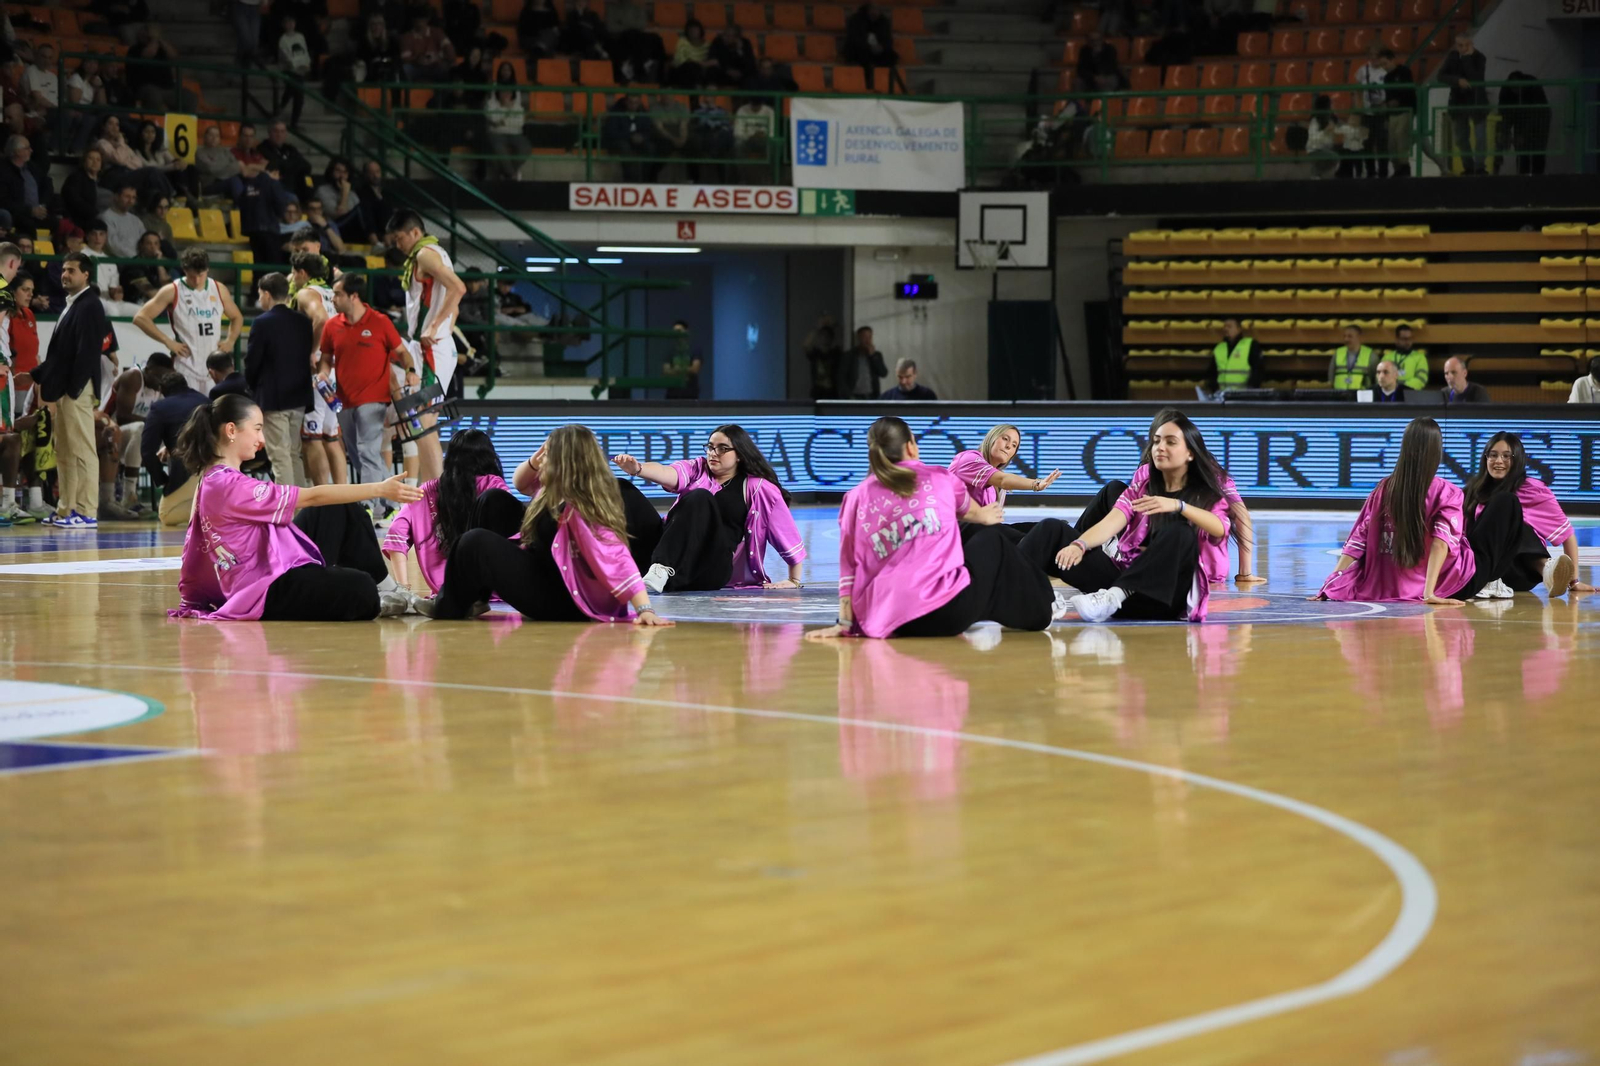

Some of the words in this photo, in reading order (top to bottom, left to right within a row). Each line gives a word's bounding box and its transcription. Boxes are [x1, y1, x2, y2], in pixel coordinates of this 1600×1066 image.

[1562, 0, 1600, 14] SAI
[845, 125, 892, 136] AXENCIA
[895, 126, 939, 138] GALEGA
[943, 127, 958, 138] DE
[174, 123, 189, 158] 6
[844, 138, 959, 152] DESENVOLVEMENTO
[844, 153, 881, 164] RURAL
[574, 186, 658, 208] SAIDA
[666, 188, 678, 207] E
[693, 188, 793, 209] ASEOS
[198, 322, 214, 336] 12
[862, 495, 936, 532] PASOS
